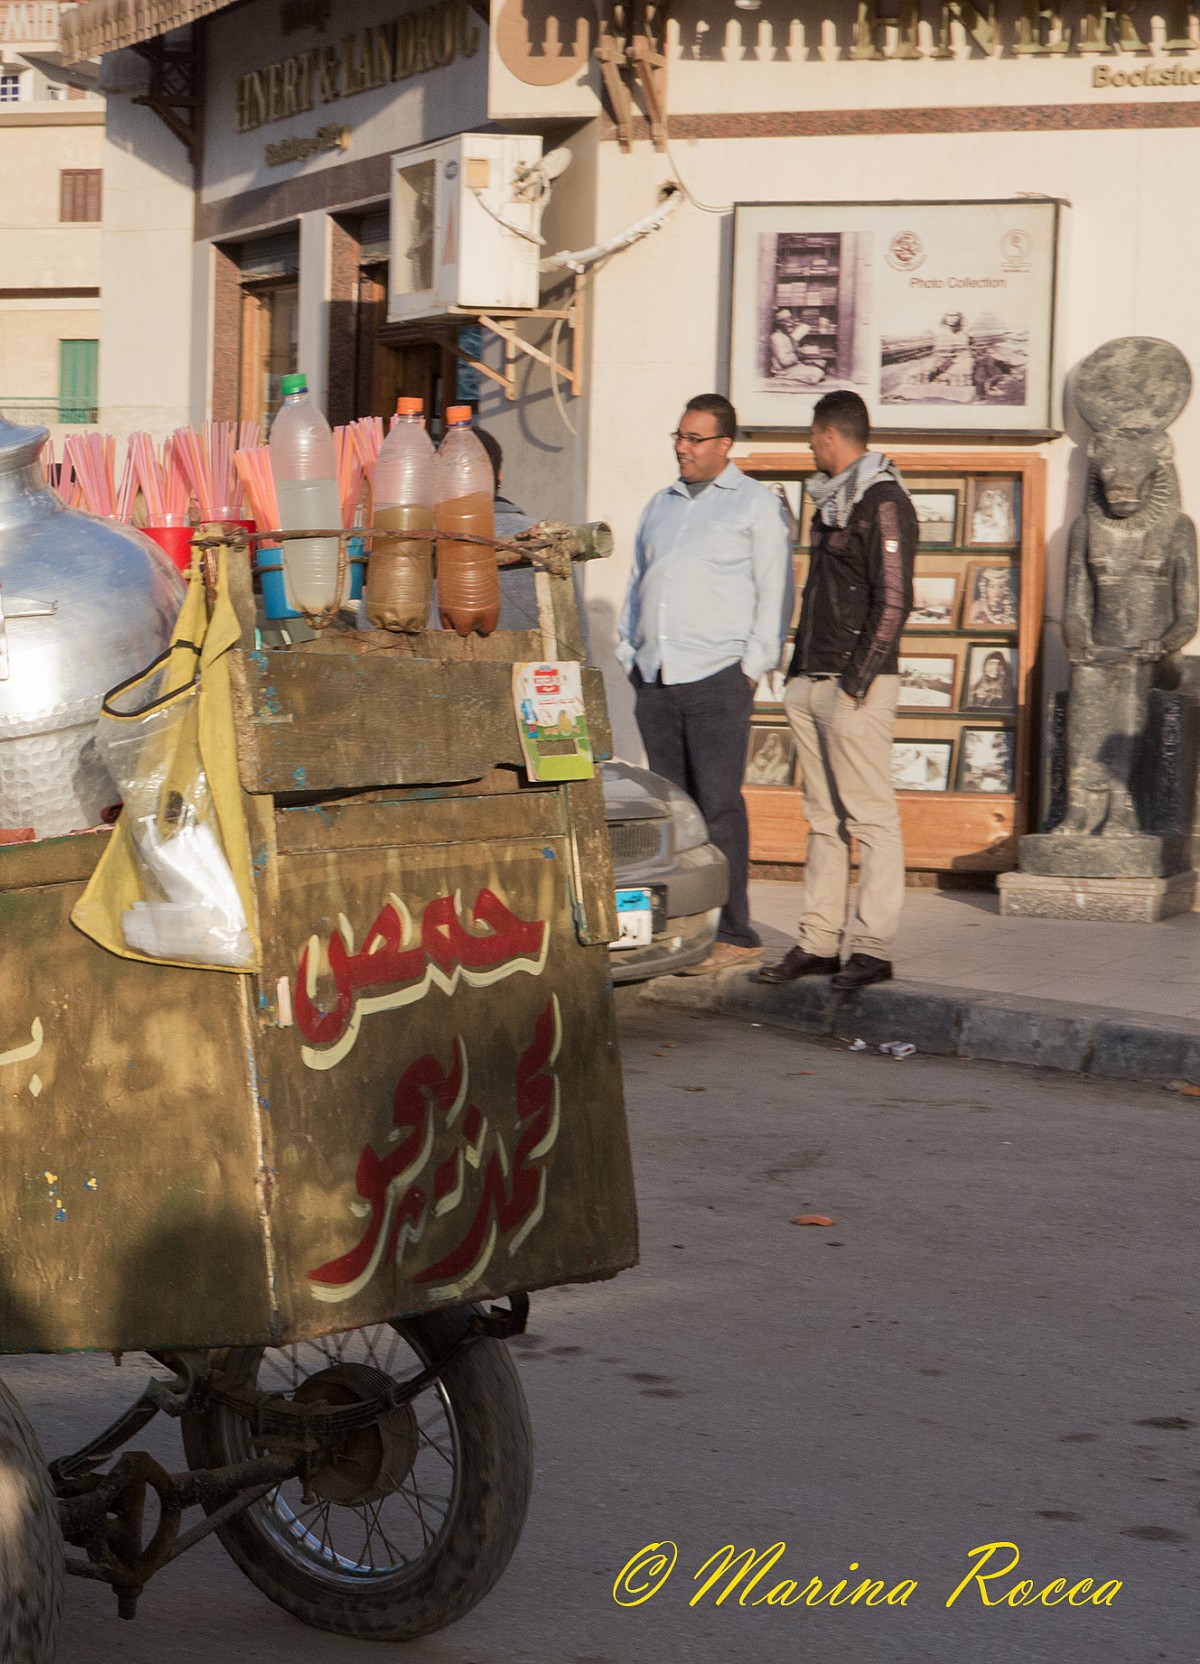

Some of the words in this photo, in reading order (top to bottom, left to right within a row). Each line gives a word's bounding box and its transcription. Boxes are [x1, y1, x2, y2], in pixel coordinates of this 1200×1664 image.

[909, 277, 944, 288] Photo
[947, 276, 1007, 288] Collection
[294, 888, 551, 1071] حمص
